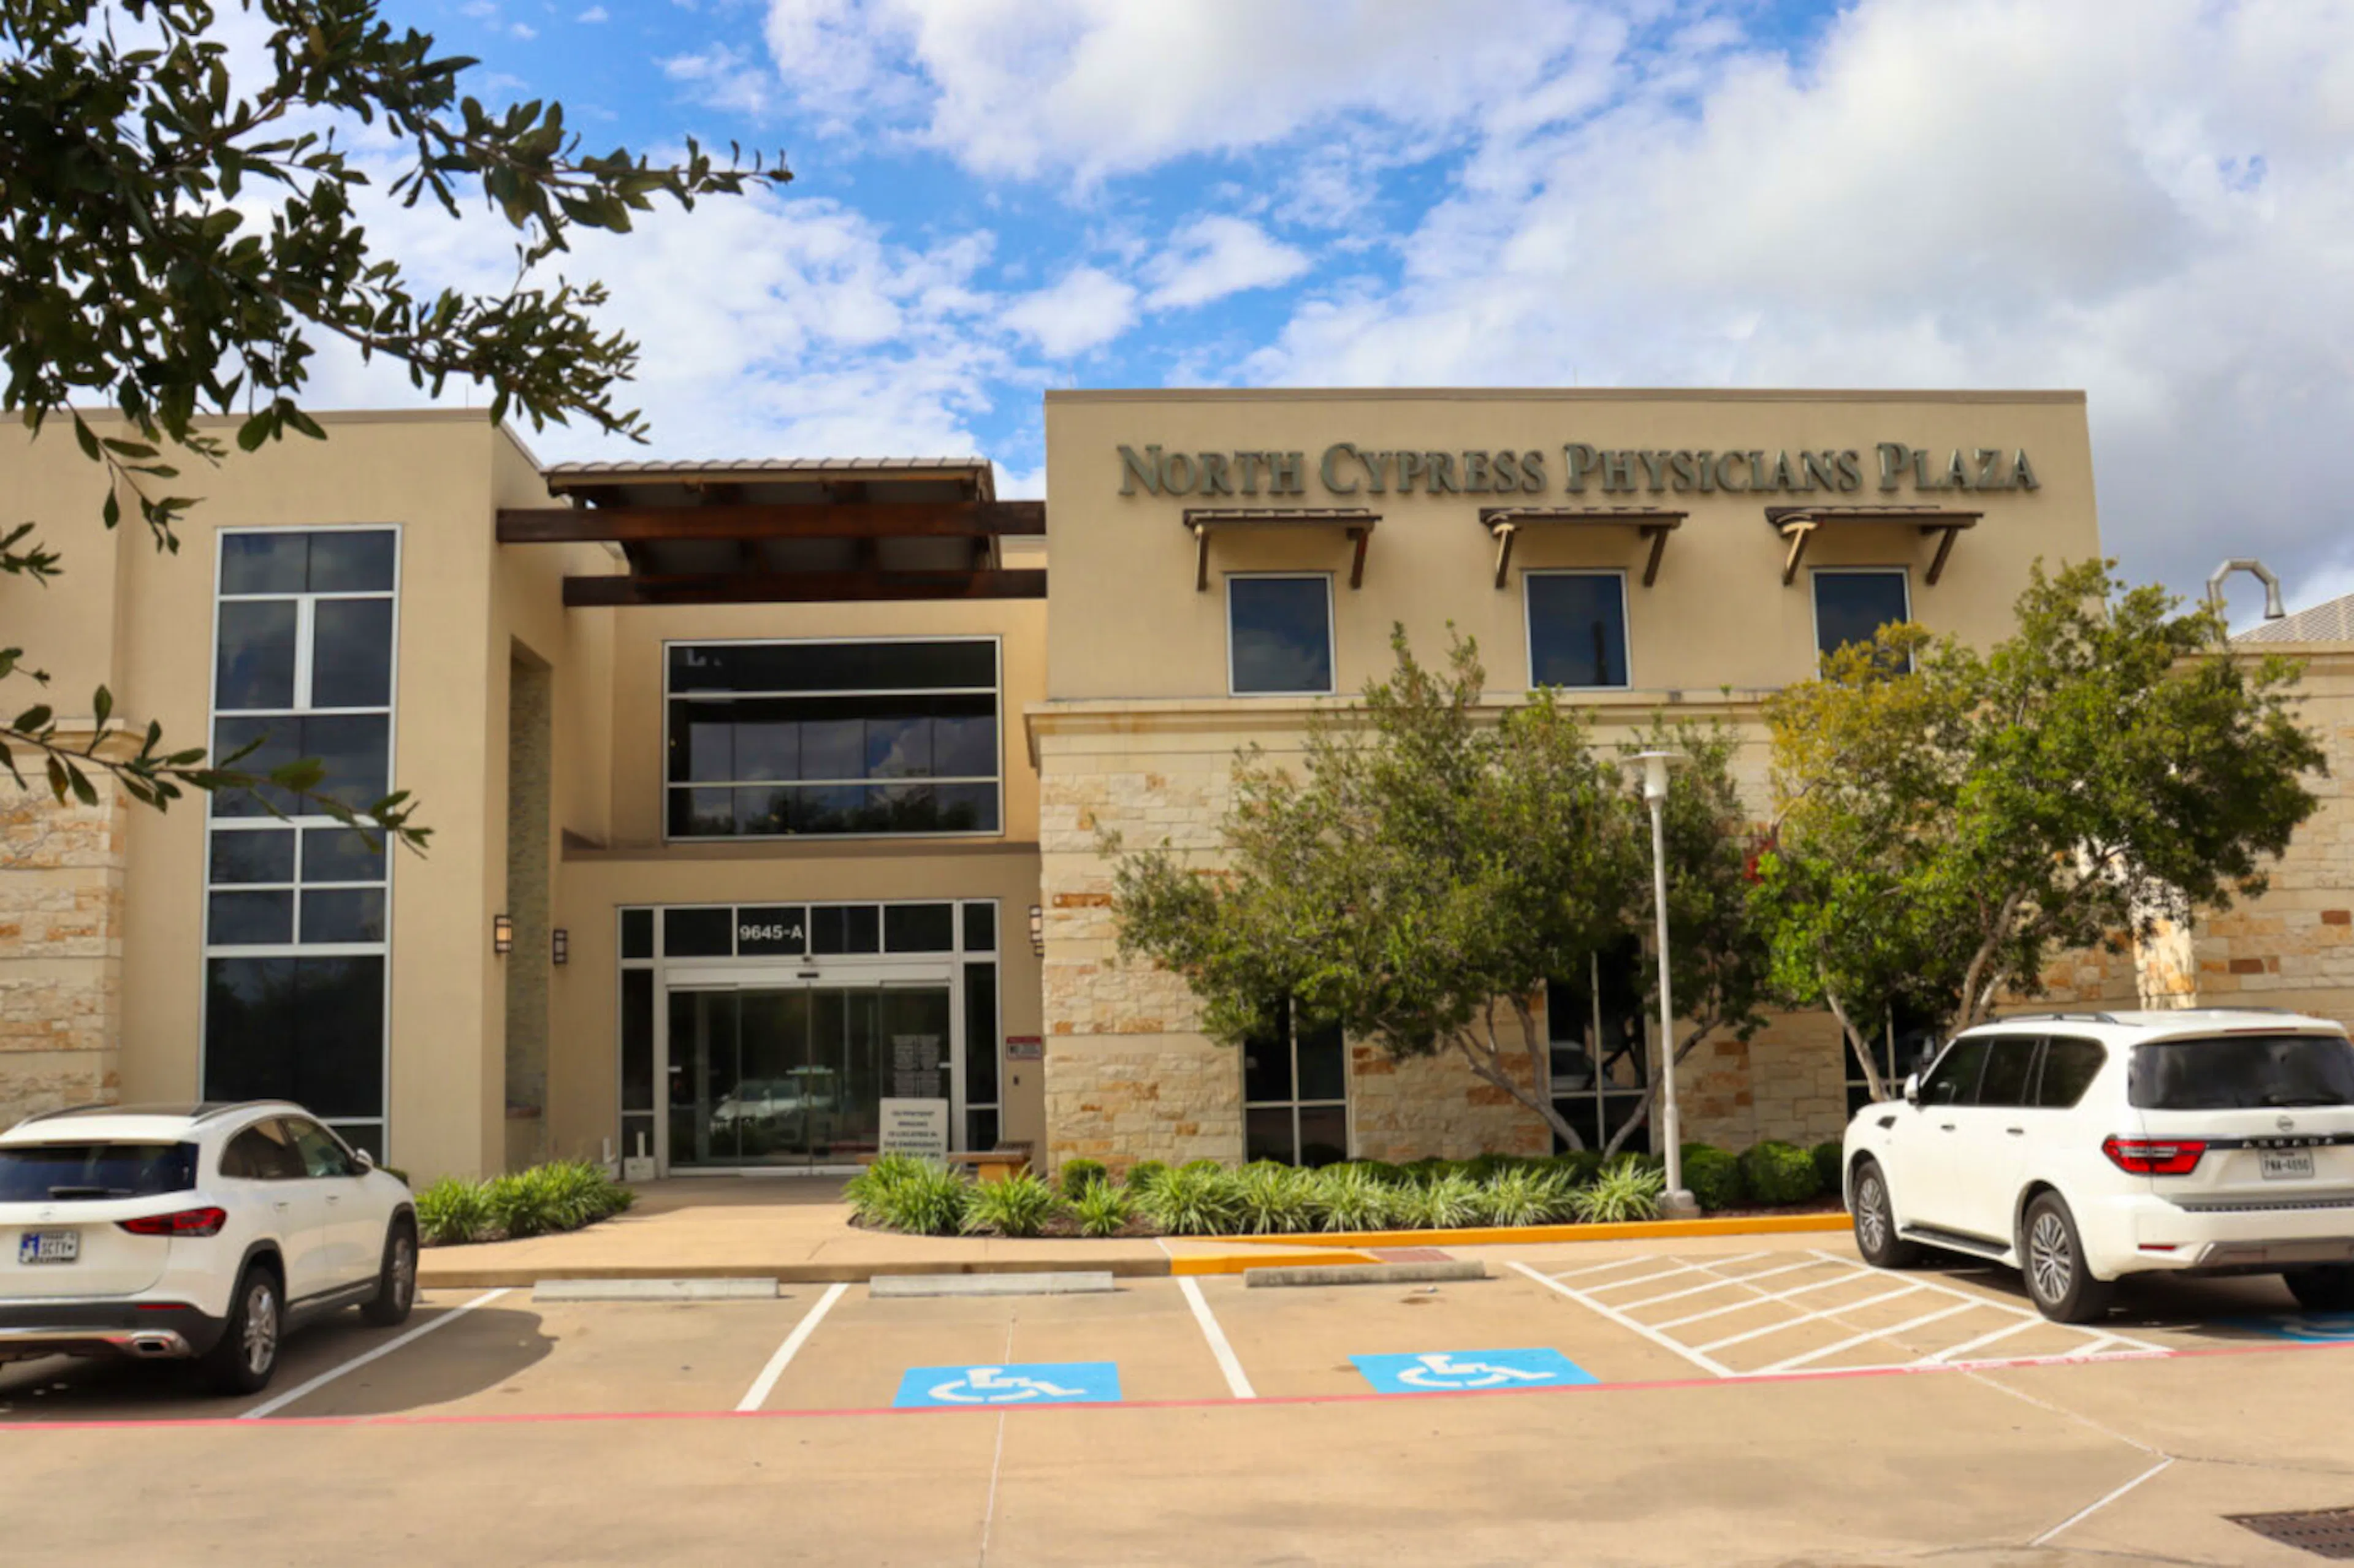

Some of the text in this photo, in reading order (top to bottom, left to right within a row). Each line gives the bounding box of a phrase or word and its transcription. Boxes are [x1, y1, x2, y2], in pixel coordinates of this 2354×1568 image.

[1116, 441, 2041, 497] NORTH CYPRESS PHYSICIANS PLAZA
[739, 924, 804, 940] 9645-A
